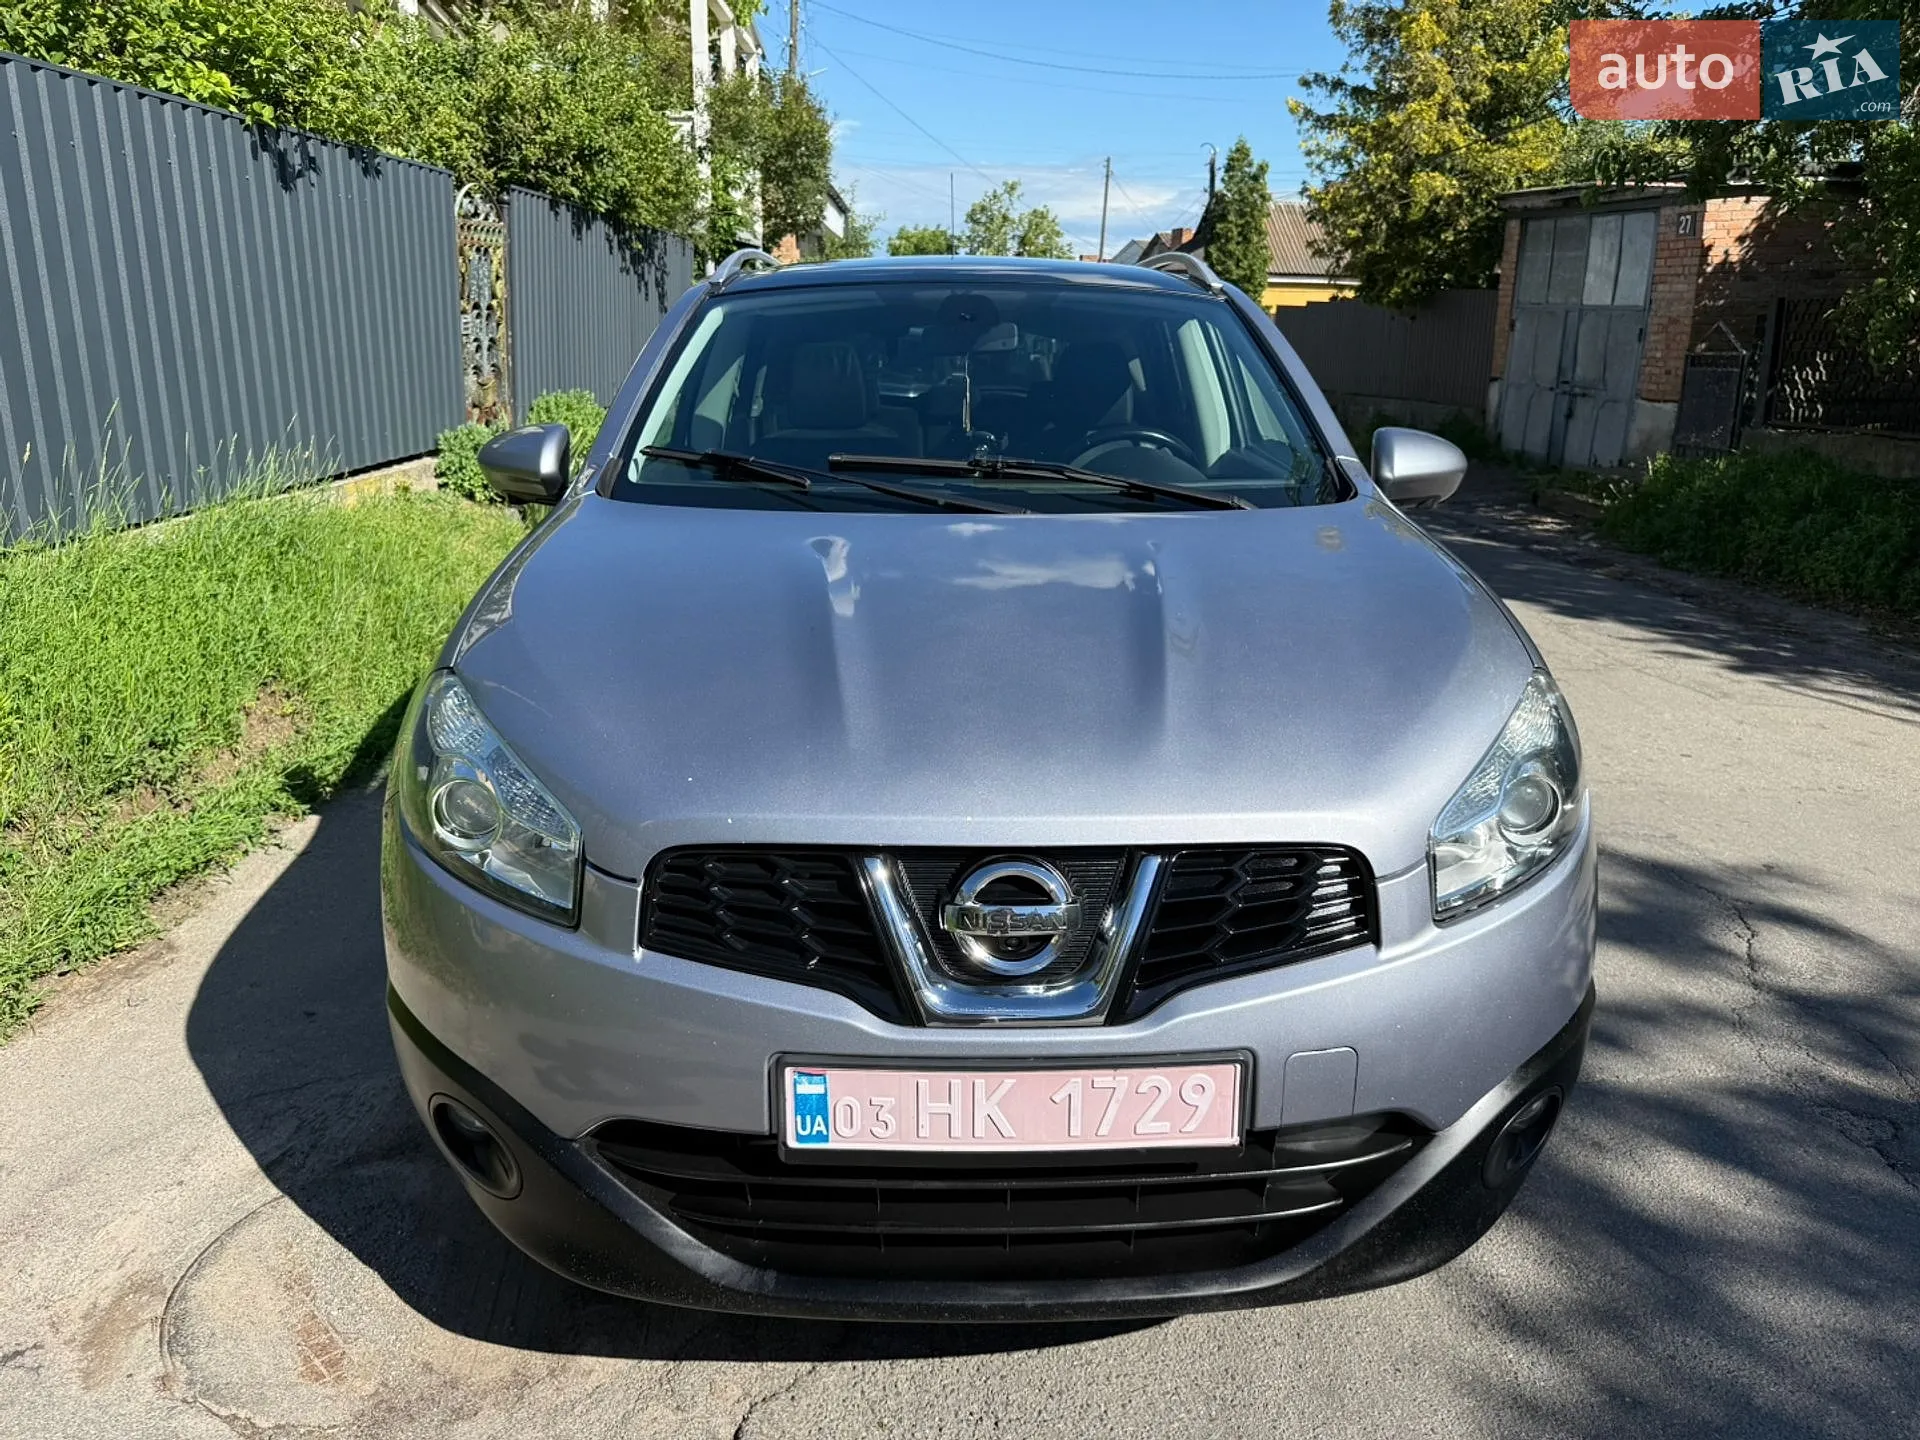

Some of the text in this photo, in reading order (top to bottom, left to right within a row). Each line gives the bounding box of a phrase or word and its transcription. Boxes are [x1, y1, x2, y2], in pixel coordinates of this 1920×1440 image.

[1678, 214, 1692, 234] 27
[833, 1073, 1217, 1139] 03 HK 1729
[796, 1114, 828, 1136] UA
